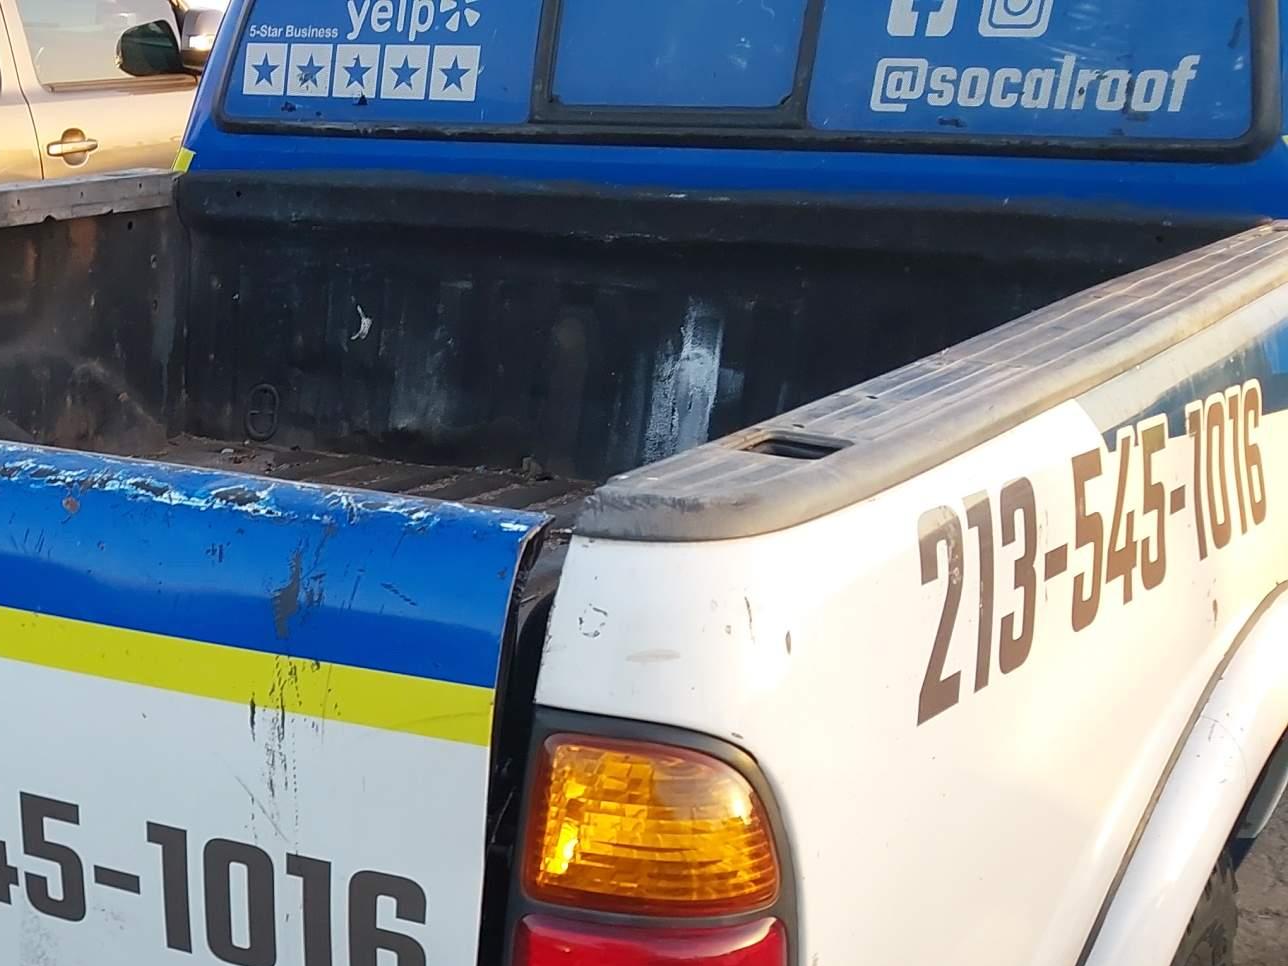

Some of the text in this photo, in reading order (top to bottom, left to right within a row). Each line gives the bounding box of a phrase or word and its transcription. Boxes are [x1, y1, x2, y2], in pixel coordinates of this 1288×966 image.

[249, 25, 339, 38] 5-Star Business
[346, 0, 435, 41] yelp
[870, 55, 1201, 112] @socalroof
[916, 379, 1267, 726] 213-545-1016
